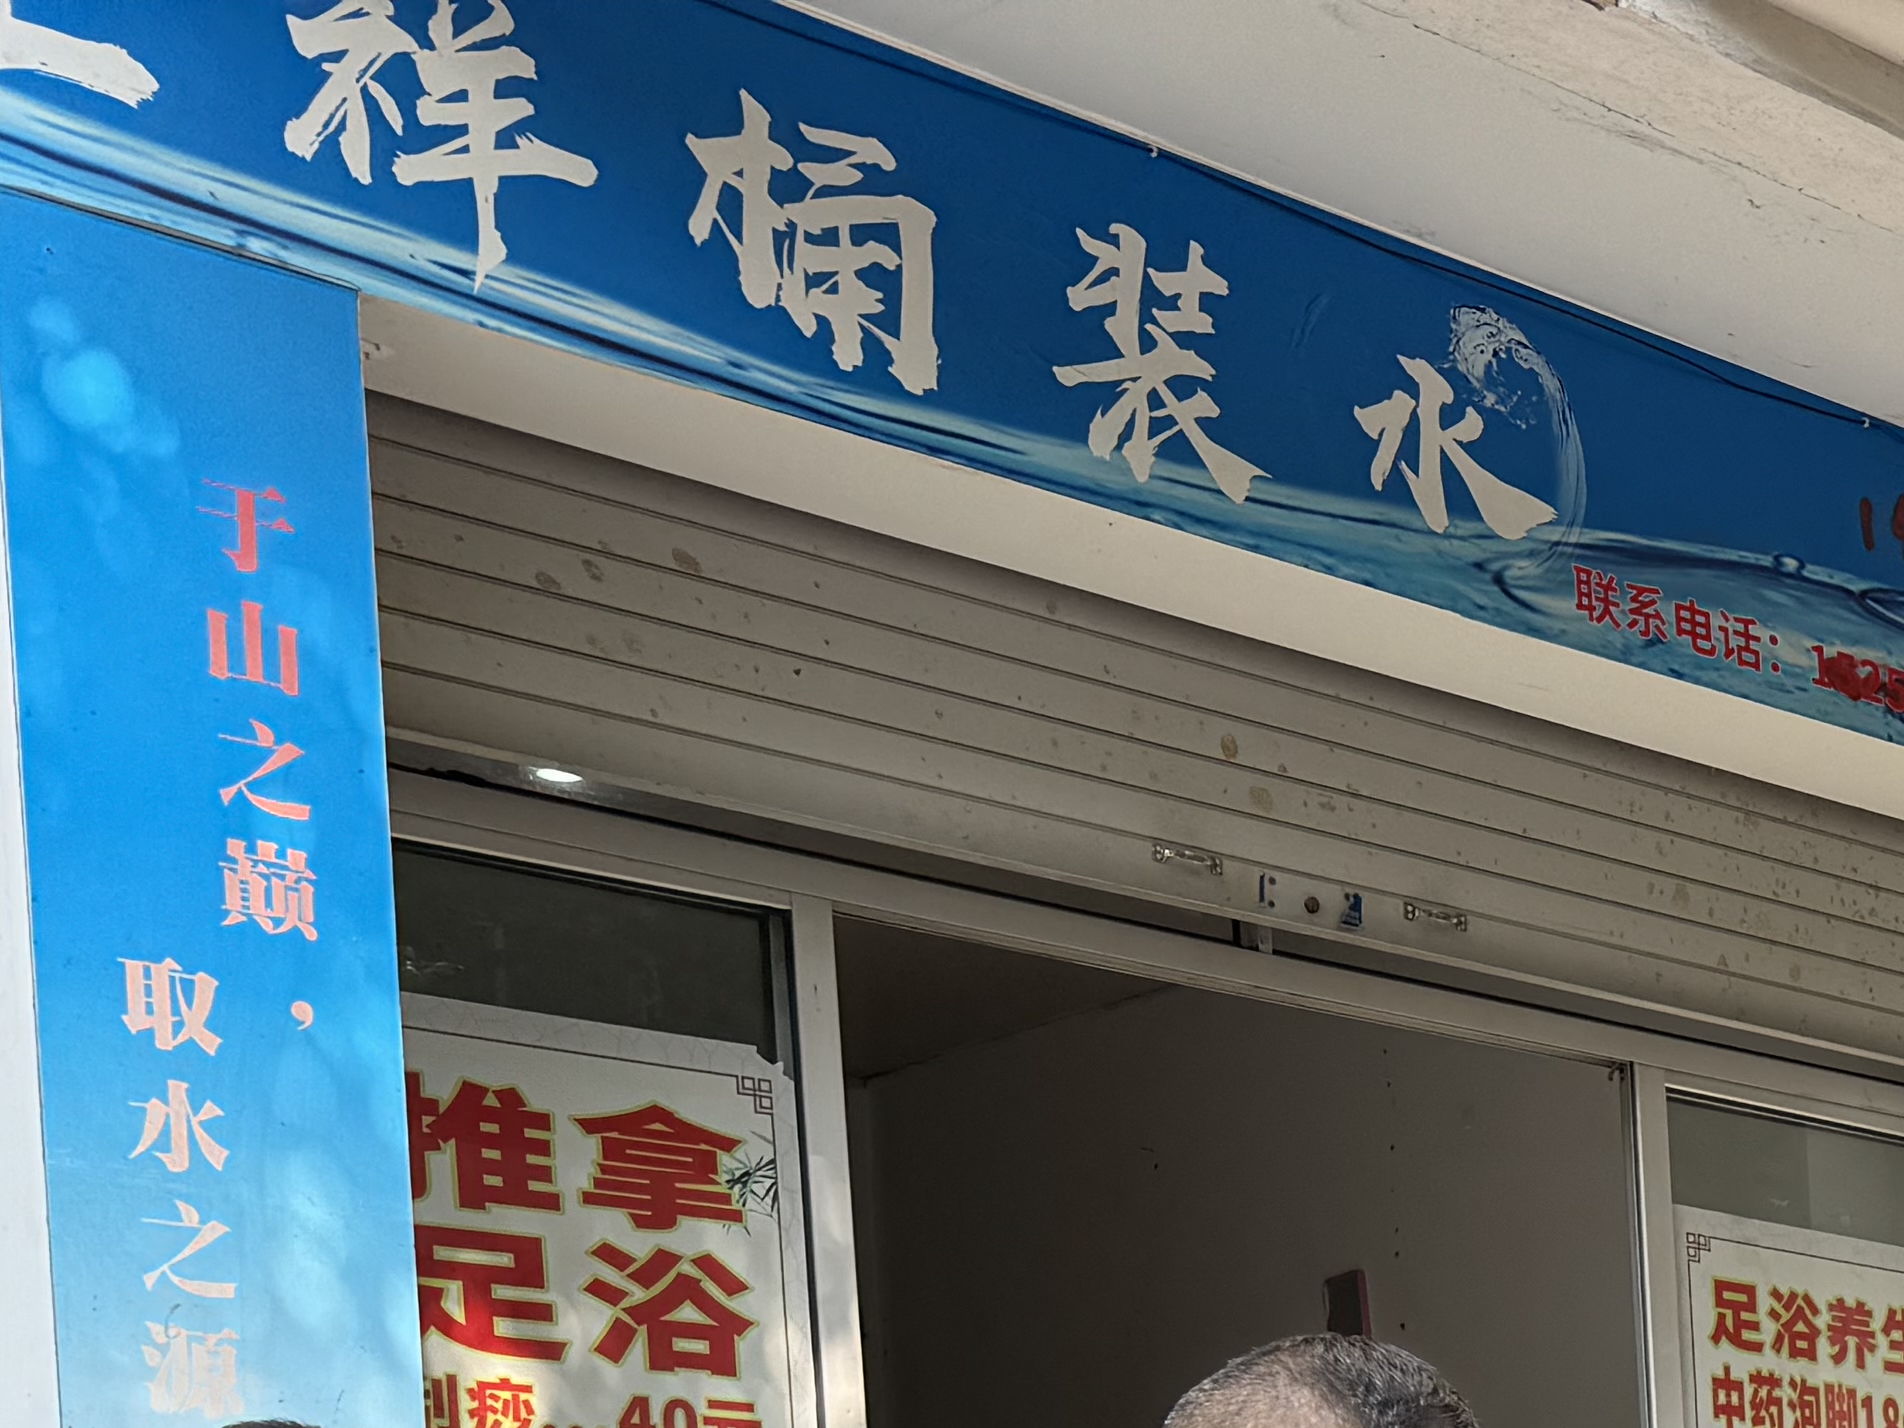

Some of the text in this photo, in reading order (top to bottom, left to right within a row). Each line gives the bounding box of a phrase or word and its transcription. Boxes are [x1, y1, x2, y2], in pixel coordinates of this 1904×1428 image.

[116, 957, 244, 1418] 取水之源
[404, 1071, 747, 1230] 推拿
[415, 1222, 760, 1380] 足浴
